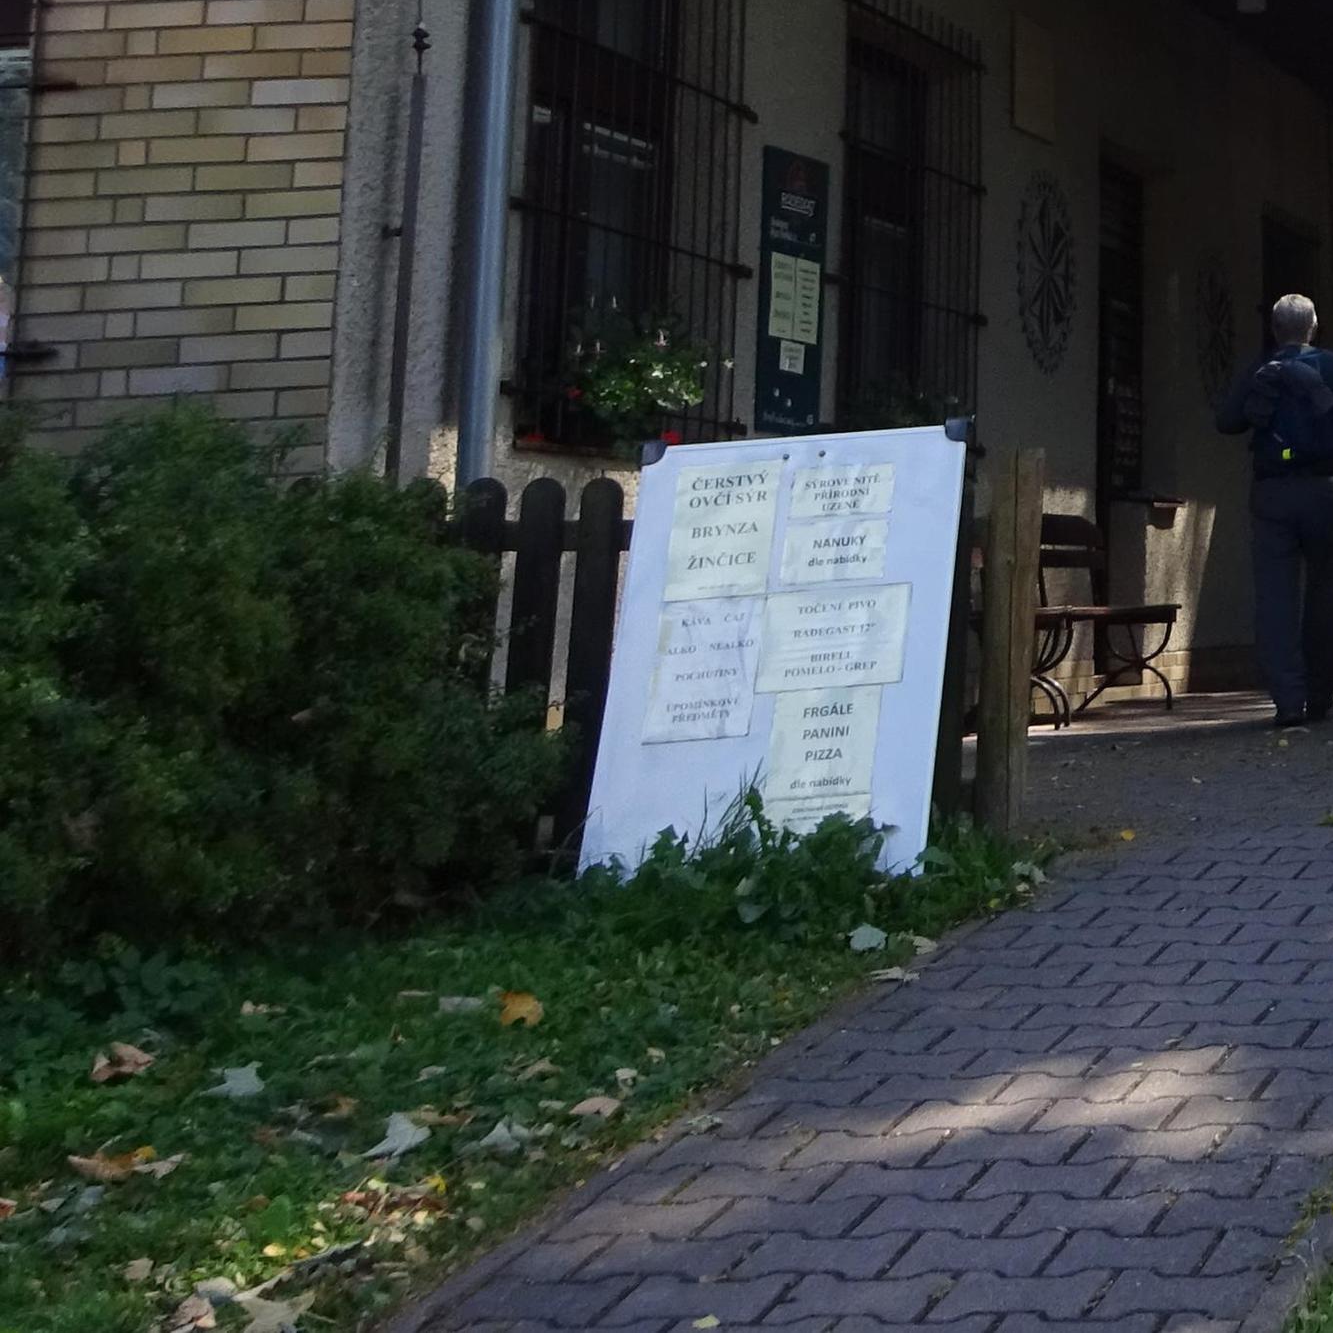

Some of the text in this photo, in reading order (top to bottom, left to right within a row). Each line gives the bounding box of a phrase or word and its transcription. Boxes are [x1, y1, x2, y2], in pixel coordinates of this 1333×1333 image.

[691, 469, 769, 492] ČERSTVÝ
[689, 489, 768, 509] OVČÍ SÝR
[691, 521, 759, 539] BRYNZA
[813, 535, 868, 549] NANUKY
[687, 551, 758, 571] ŽINČICE
[808, 554, 868, 567] dle nabídky
[848, 599, 877, 611] PIVO
[792, 624, 857, 639] RADEGAST
[810, 650, 853, 663] BIRELL
[784, 664, 836, 678] POMELO
[845, 660, 878, 672] GREP
[803, 702, 855, 719] FRGÁLE
[802, 725, 850, 740] PANINI
[804, 748, 842, 762] PIZZA
[790, 775, 852, 789] dle nabídky
